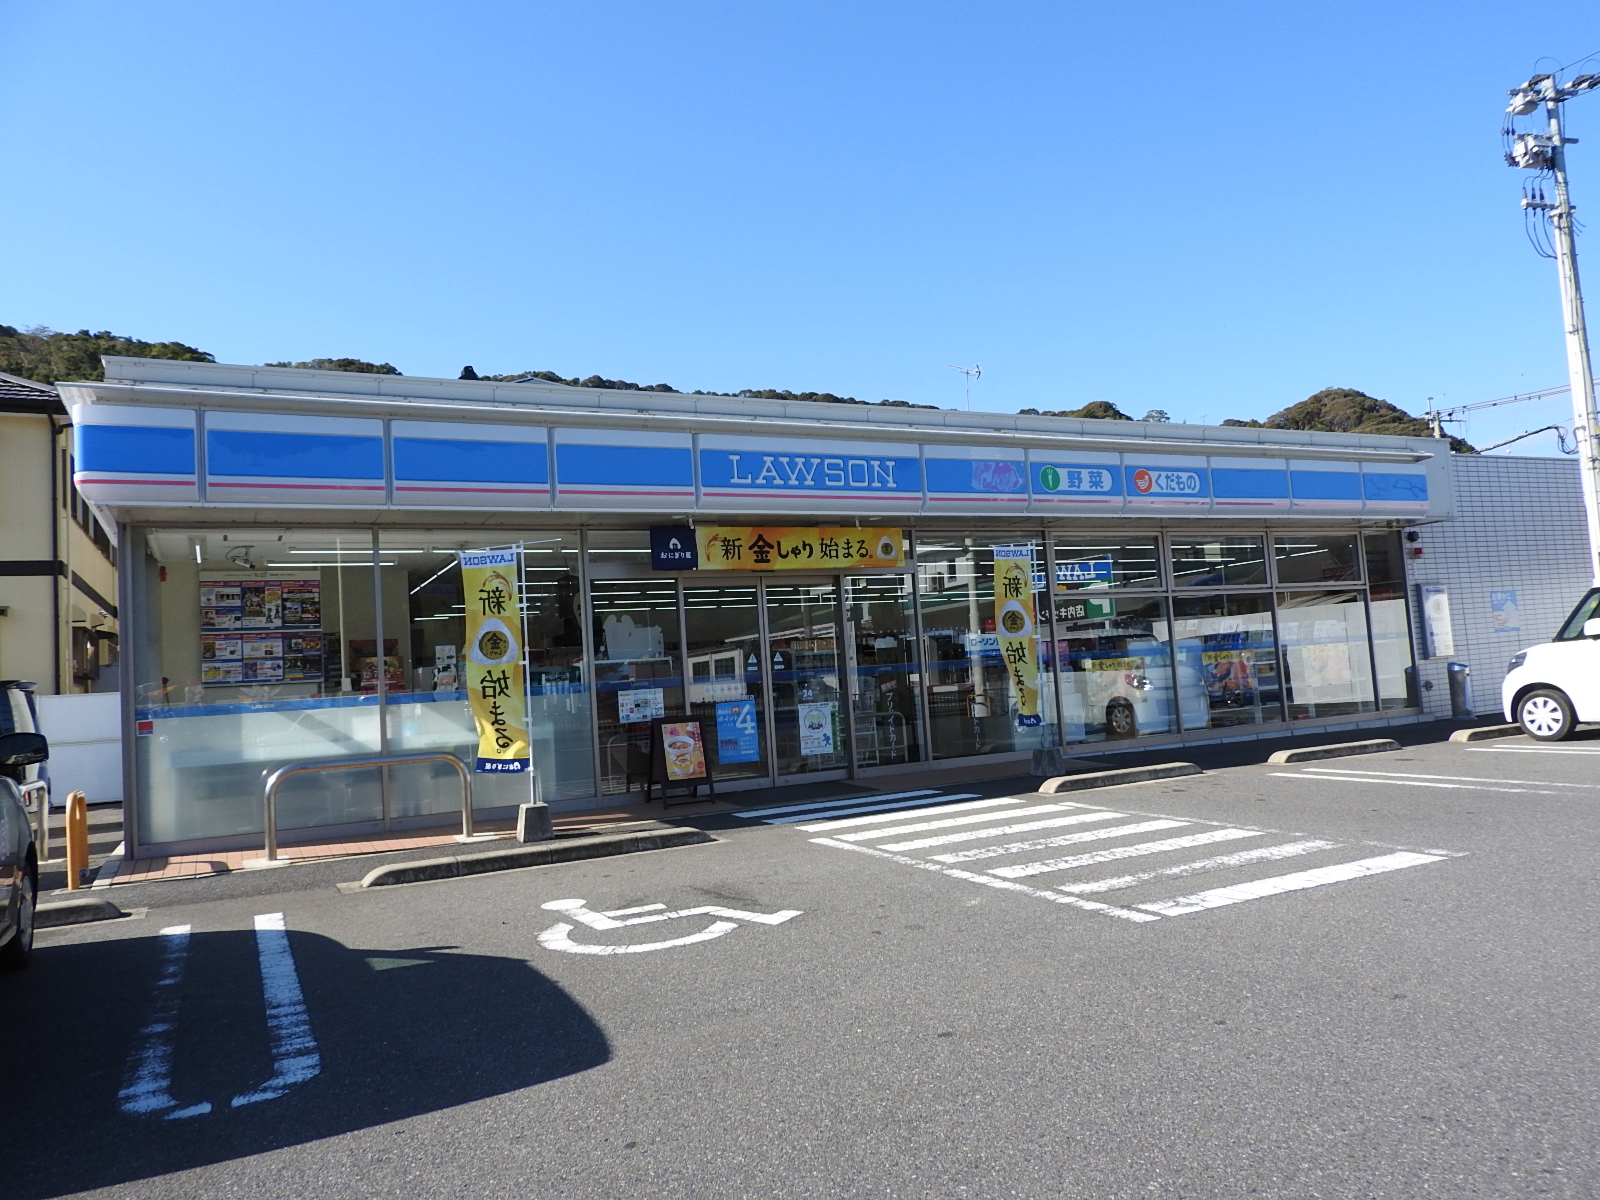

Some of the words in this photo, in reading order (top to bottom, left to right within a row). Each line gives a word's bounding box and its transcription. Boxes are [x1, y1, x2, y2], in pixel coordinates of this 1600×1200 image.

[728, 454, 898, 488] LAWSON
[1067, 470, 1105, 490] 野菜
[1154, 472, 1197, 491] くだもの
[735, 703, 756, 735] 4
